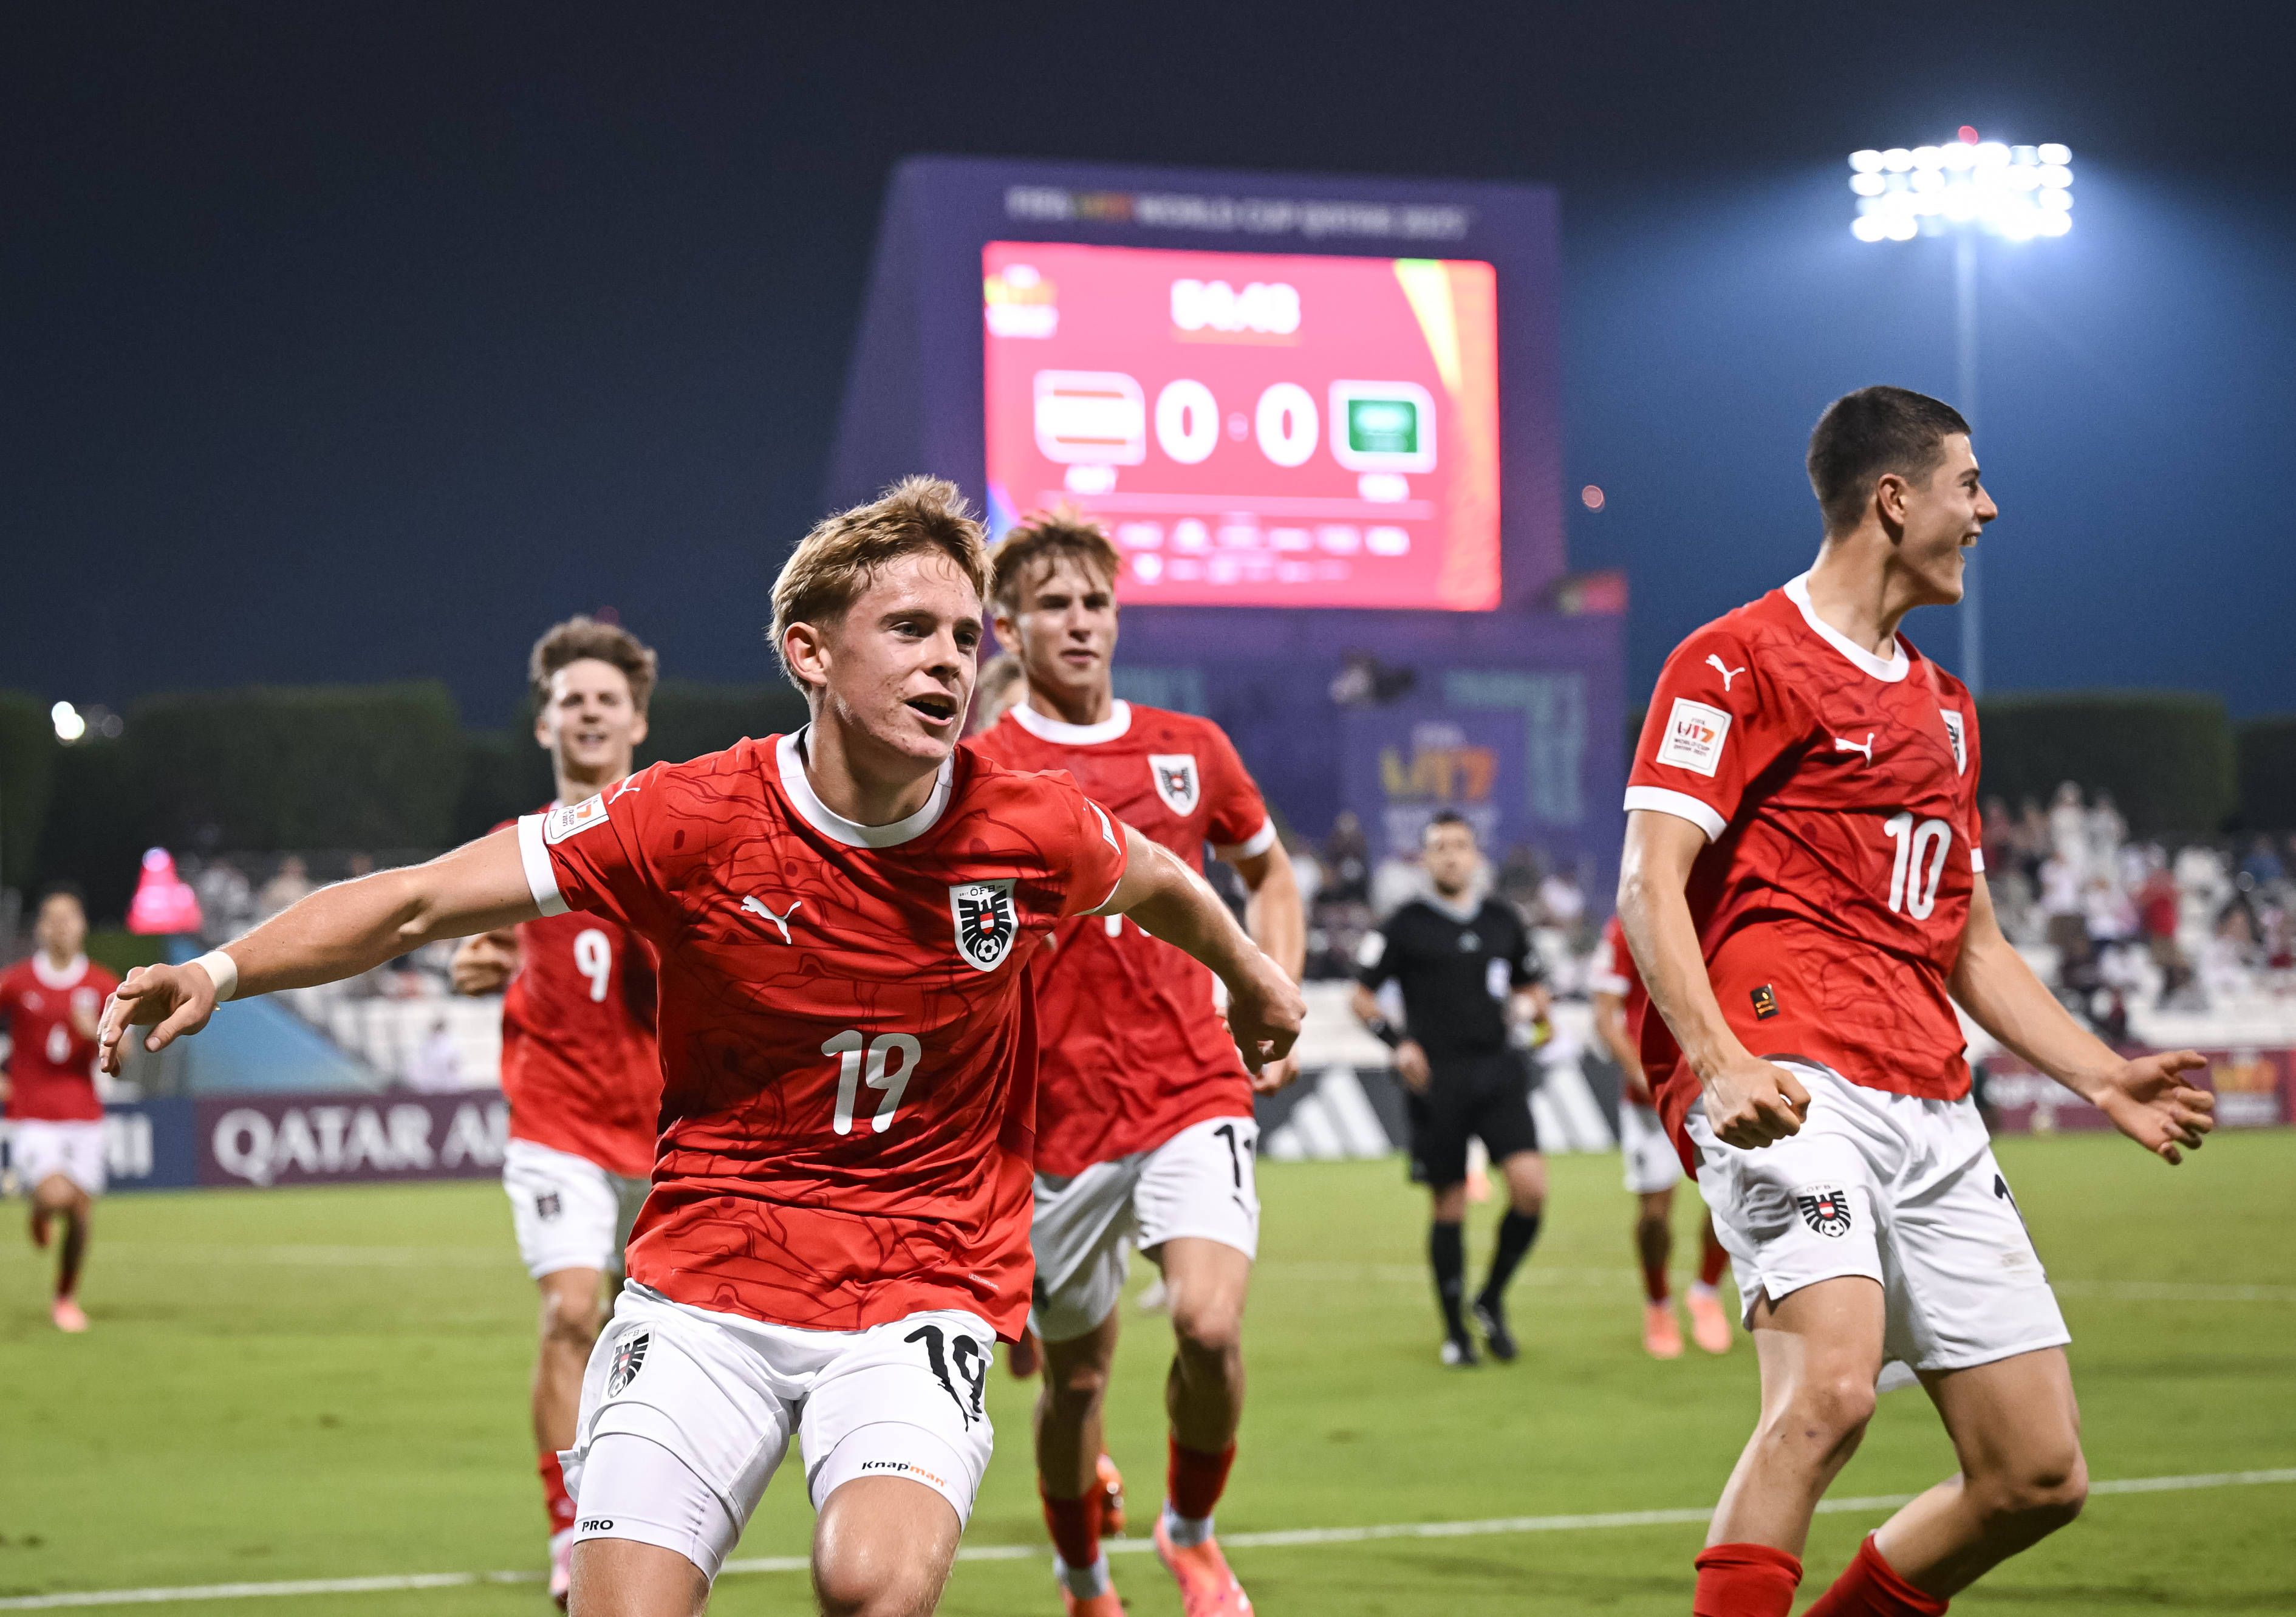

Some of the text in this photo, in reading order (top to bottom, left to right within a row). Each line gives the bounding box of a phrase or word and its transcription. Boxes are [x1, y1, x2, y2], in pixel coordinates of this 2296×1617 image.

[1155, 379, 1219, 464] 0
[1256, 382, 1319, 467] 0
[1677, 721, 1715, 744] U17
[970, 885, 995, 896] ÖFB
[1884, 812, 1952, 920] 10
[573, 929, 612, 1002] 9
[821, 1030, 921, 1135] 19
[212, 1107, 436, 1186] QATAR
[904, 1325, 985, 1432] 19
[582, 1519, 613, 1532] PRO
